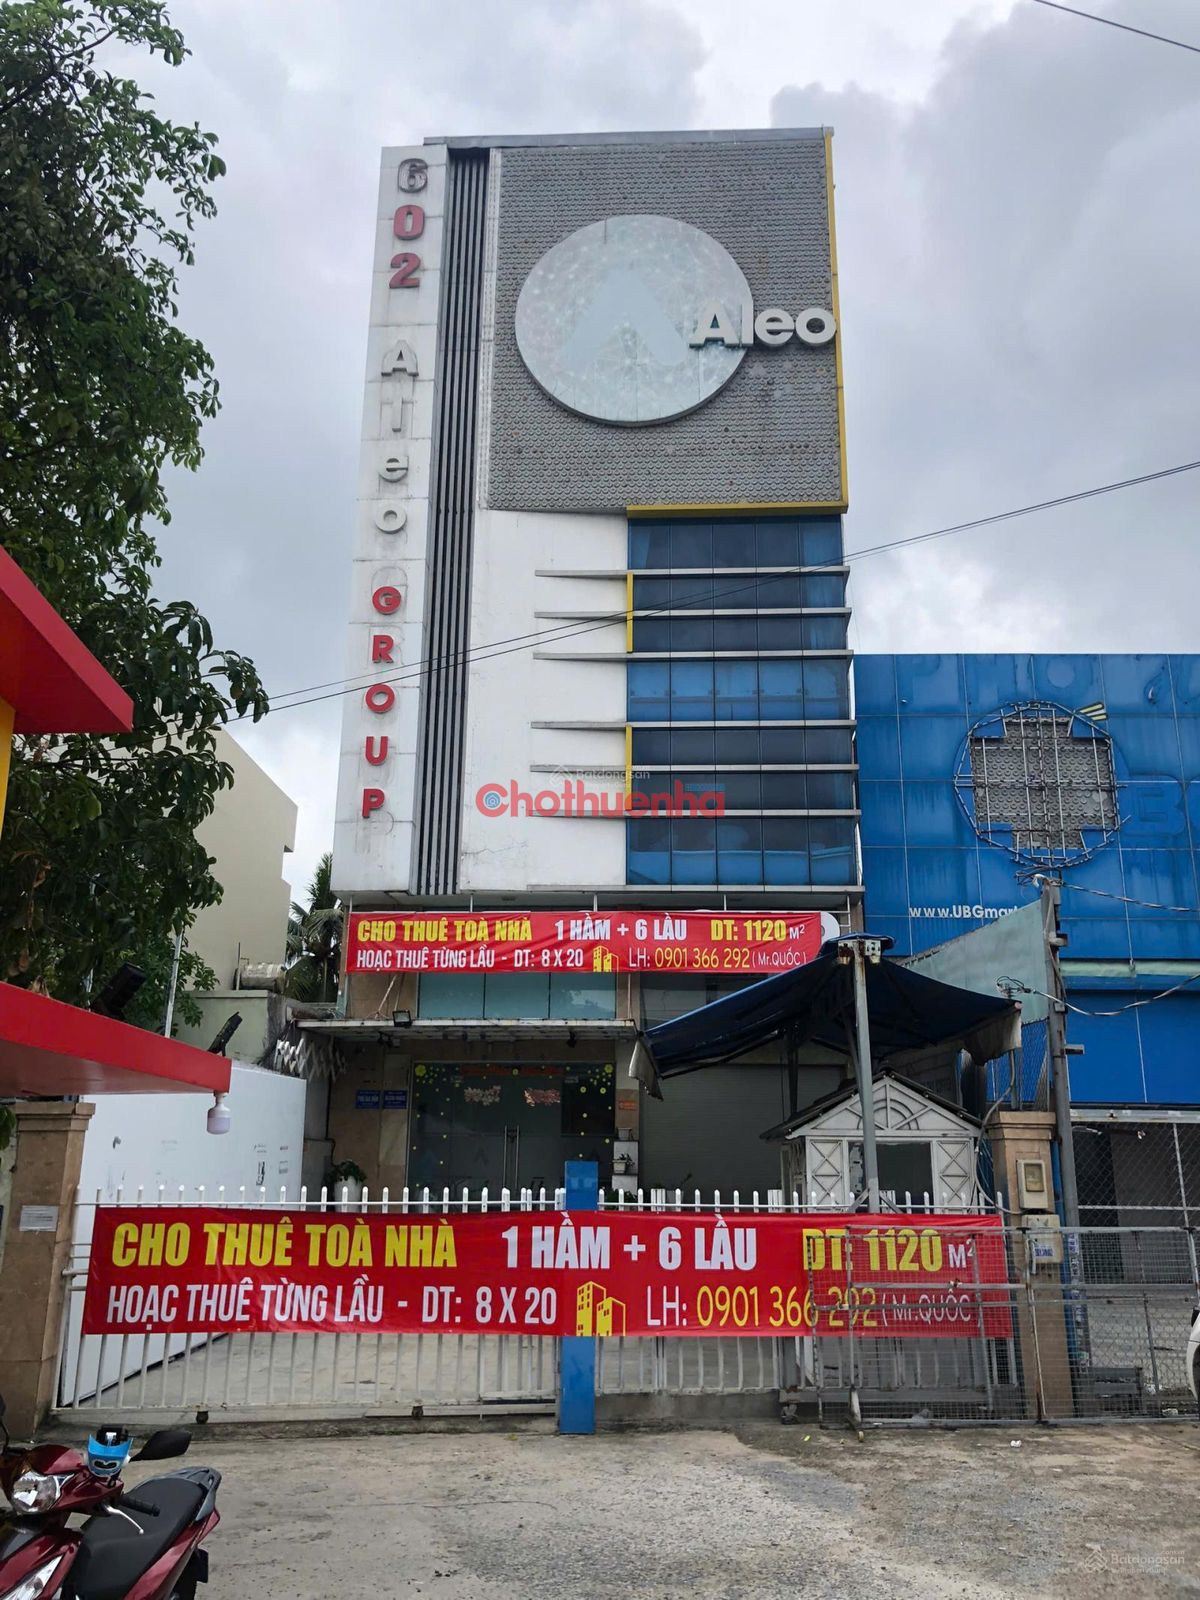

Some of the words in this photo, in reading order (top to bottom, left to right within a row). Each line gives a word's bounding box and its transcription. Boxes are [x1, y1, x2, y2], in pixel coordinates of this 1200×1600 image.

[389, 158, 428, 289] 602
[689, 297, 837, 348] Aleo
[362, 586, 402, 818] GROUP
[357, 919, 396, 941] CHO
[402, 917, 448, 941] THUÊ
[454, 917, 490, 941] TOÀ
[495, 917, 532, 941] NHÀ
[555, 920, 564, 940] 1
[570, 912, 610, 940] HẦM
[617, 923, 629, 936] +
[635, 919, 648, 940] 6
[654, 912, 687, 940] LẦU
[710, 919, 738, 941] DT:
[743, 919, 787, 941] 1120
[396, 946, 429, 968] THUÊ
[432, 946, 466, 968] TỪNG
[470, 944, 495, 968] LẦU
[514, 949, 535, 967] DT:
[541, 949, 550, 967] 8
[554, 949, 563, 967] X
[567, 949, 583, 967] 20
[628, 948, 650, 968] LH:
[654, 947, 688, 968] 0901
[692, 947, 719, 968] 366
[724, 947, 750, 968] 292
[111, 1222, 191, 1267] CHO
[203, 1216, 294, 1267] THUÊ
[305, 1217, 373, 1267] TOÀ
[385, 1218, 457, 1267] NHÀ
[502, 1226, 518, 1268] 1
[531, 1212, 610, 1269] HẦM
[623, 1235, 646, 1261] +
[659, 1226, 682, 1270] 6
[695, 1214, 757, 1270] LẦU
[803, 1228, 853, 1270] DT:
[863, 1228, 943, 1272] 1120
[106, 1285, 179, 1331] HOẠC
[186, 1277, 254, 1323] THUÊ
[261, 1277, 328, 1323] TỪNG
[334, 1274, 384, 1323] LẦU
[422, 1285, 462, 1324] DT:
[476, 1286, 492, 1324] 8
[499, 1286, 518, 1324] X
[524, 1286, 557, 1325] 20
[647, 1285, 686, 1326] LH:
[697, 1285, 760, 1327] 0901
[769, 1285, 819, 1327] 366
[828, 1286, 878, 1327] 292
